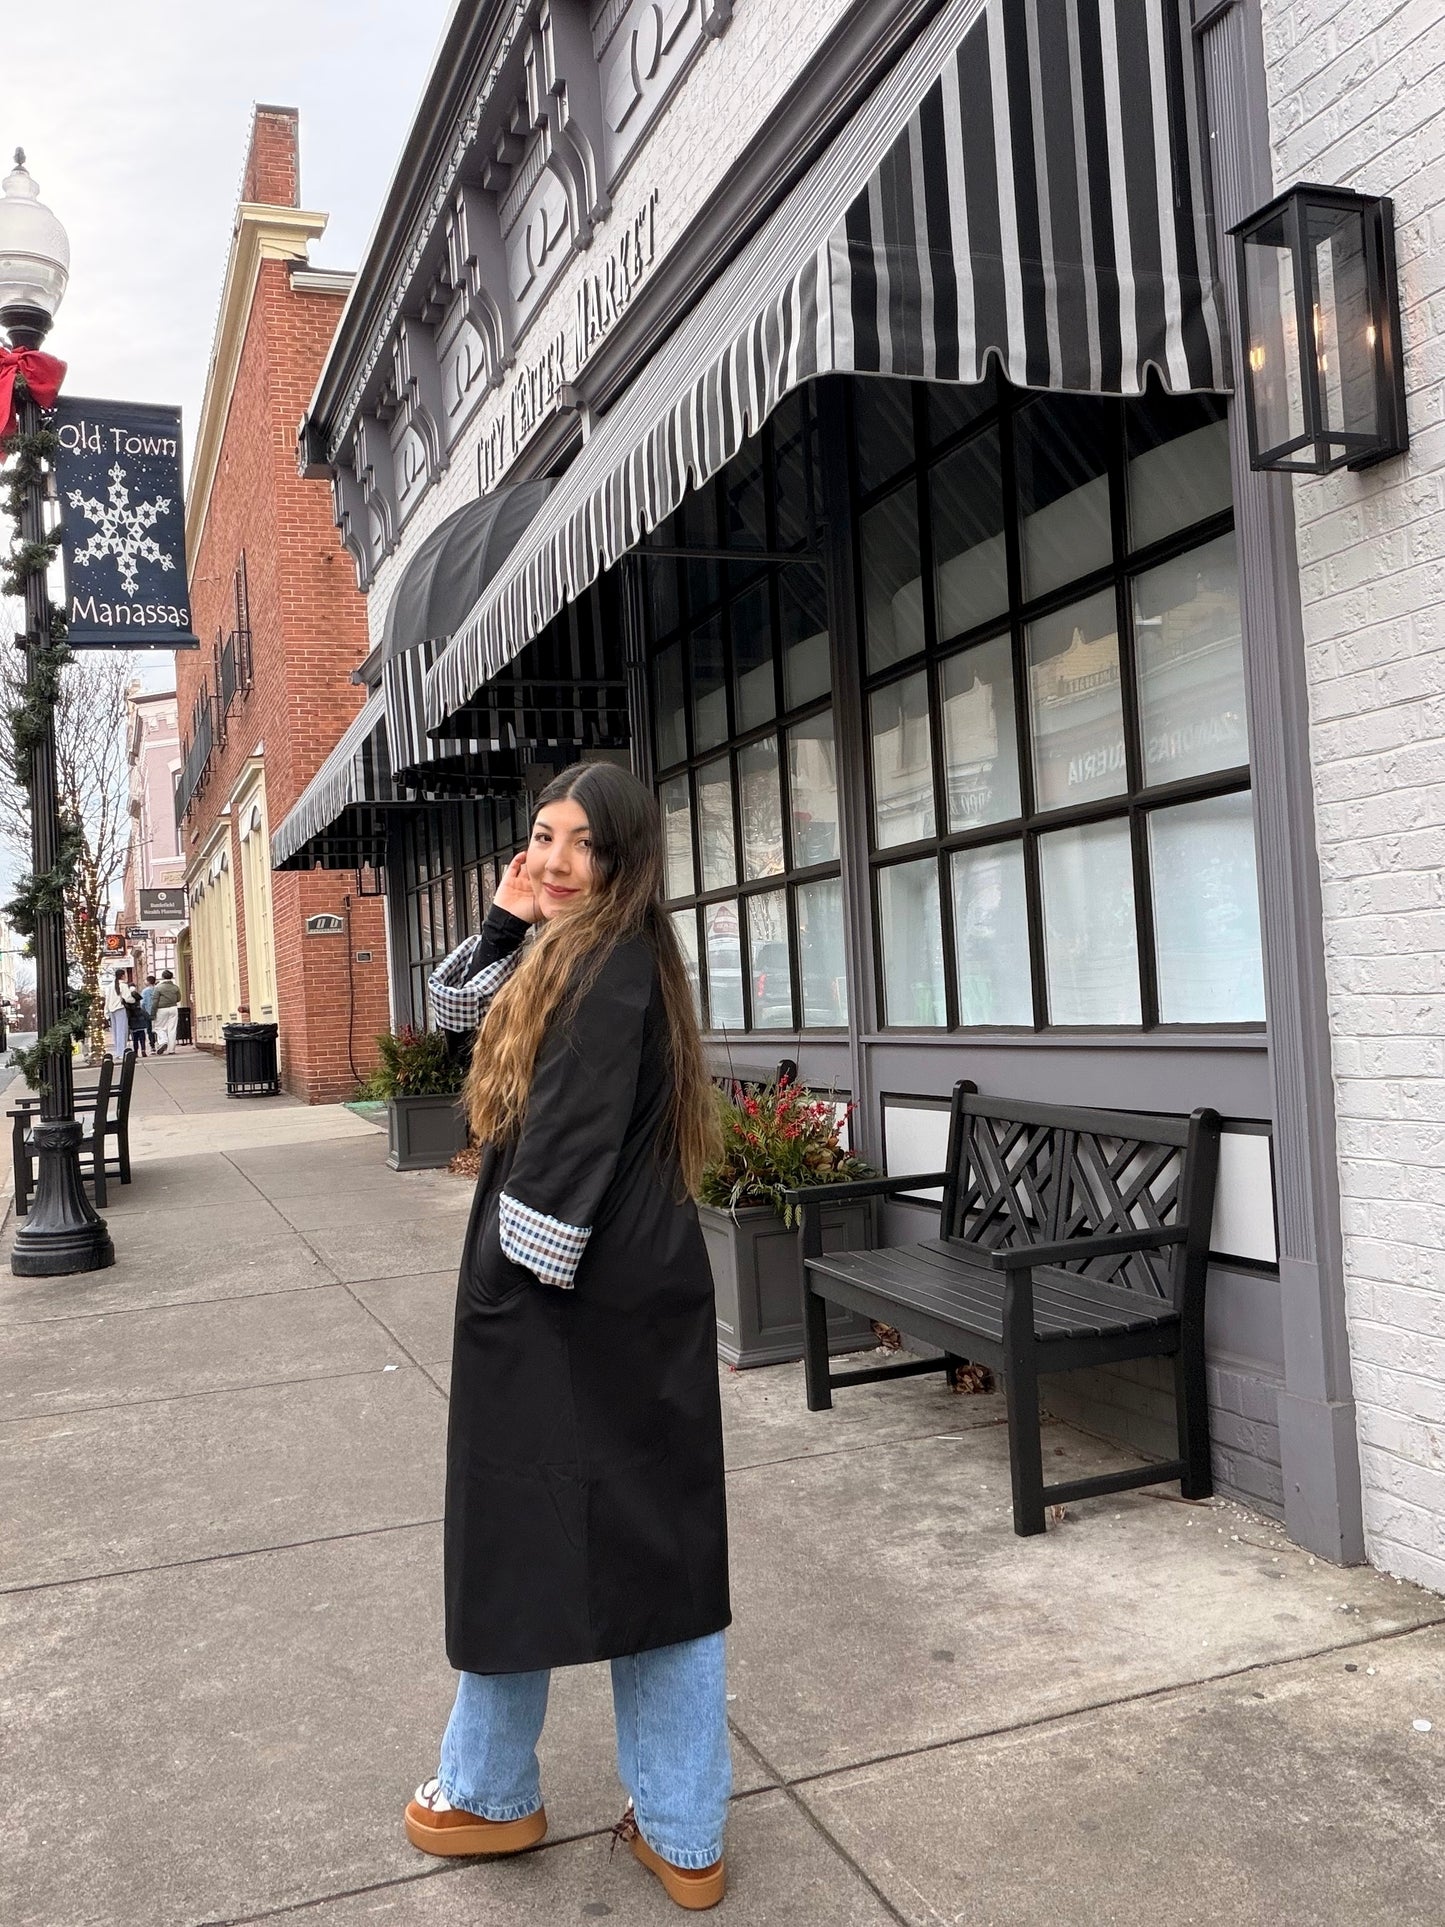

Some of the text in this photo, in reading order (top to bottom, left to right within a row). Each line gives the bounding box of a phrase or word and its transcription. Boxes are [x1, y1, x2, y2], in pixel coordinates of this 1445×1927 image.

[477, 187, 659, 497] CITY CENTER MARKET
[58, 421, 177, 457] Old Town
[71, 596, 189, 627] Manassas
